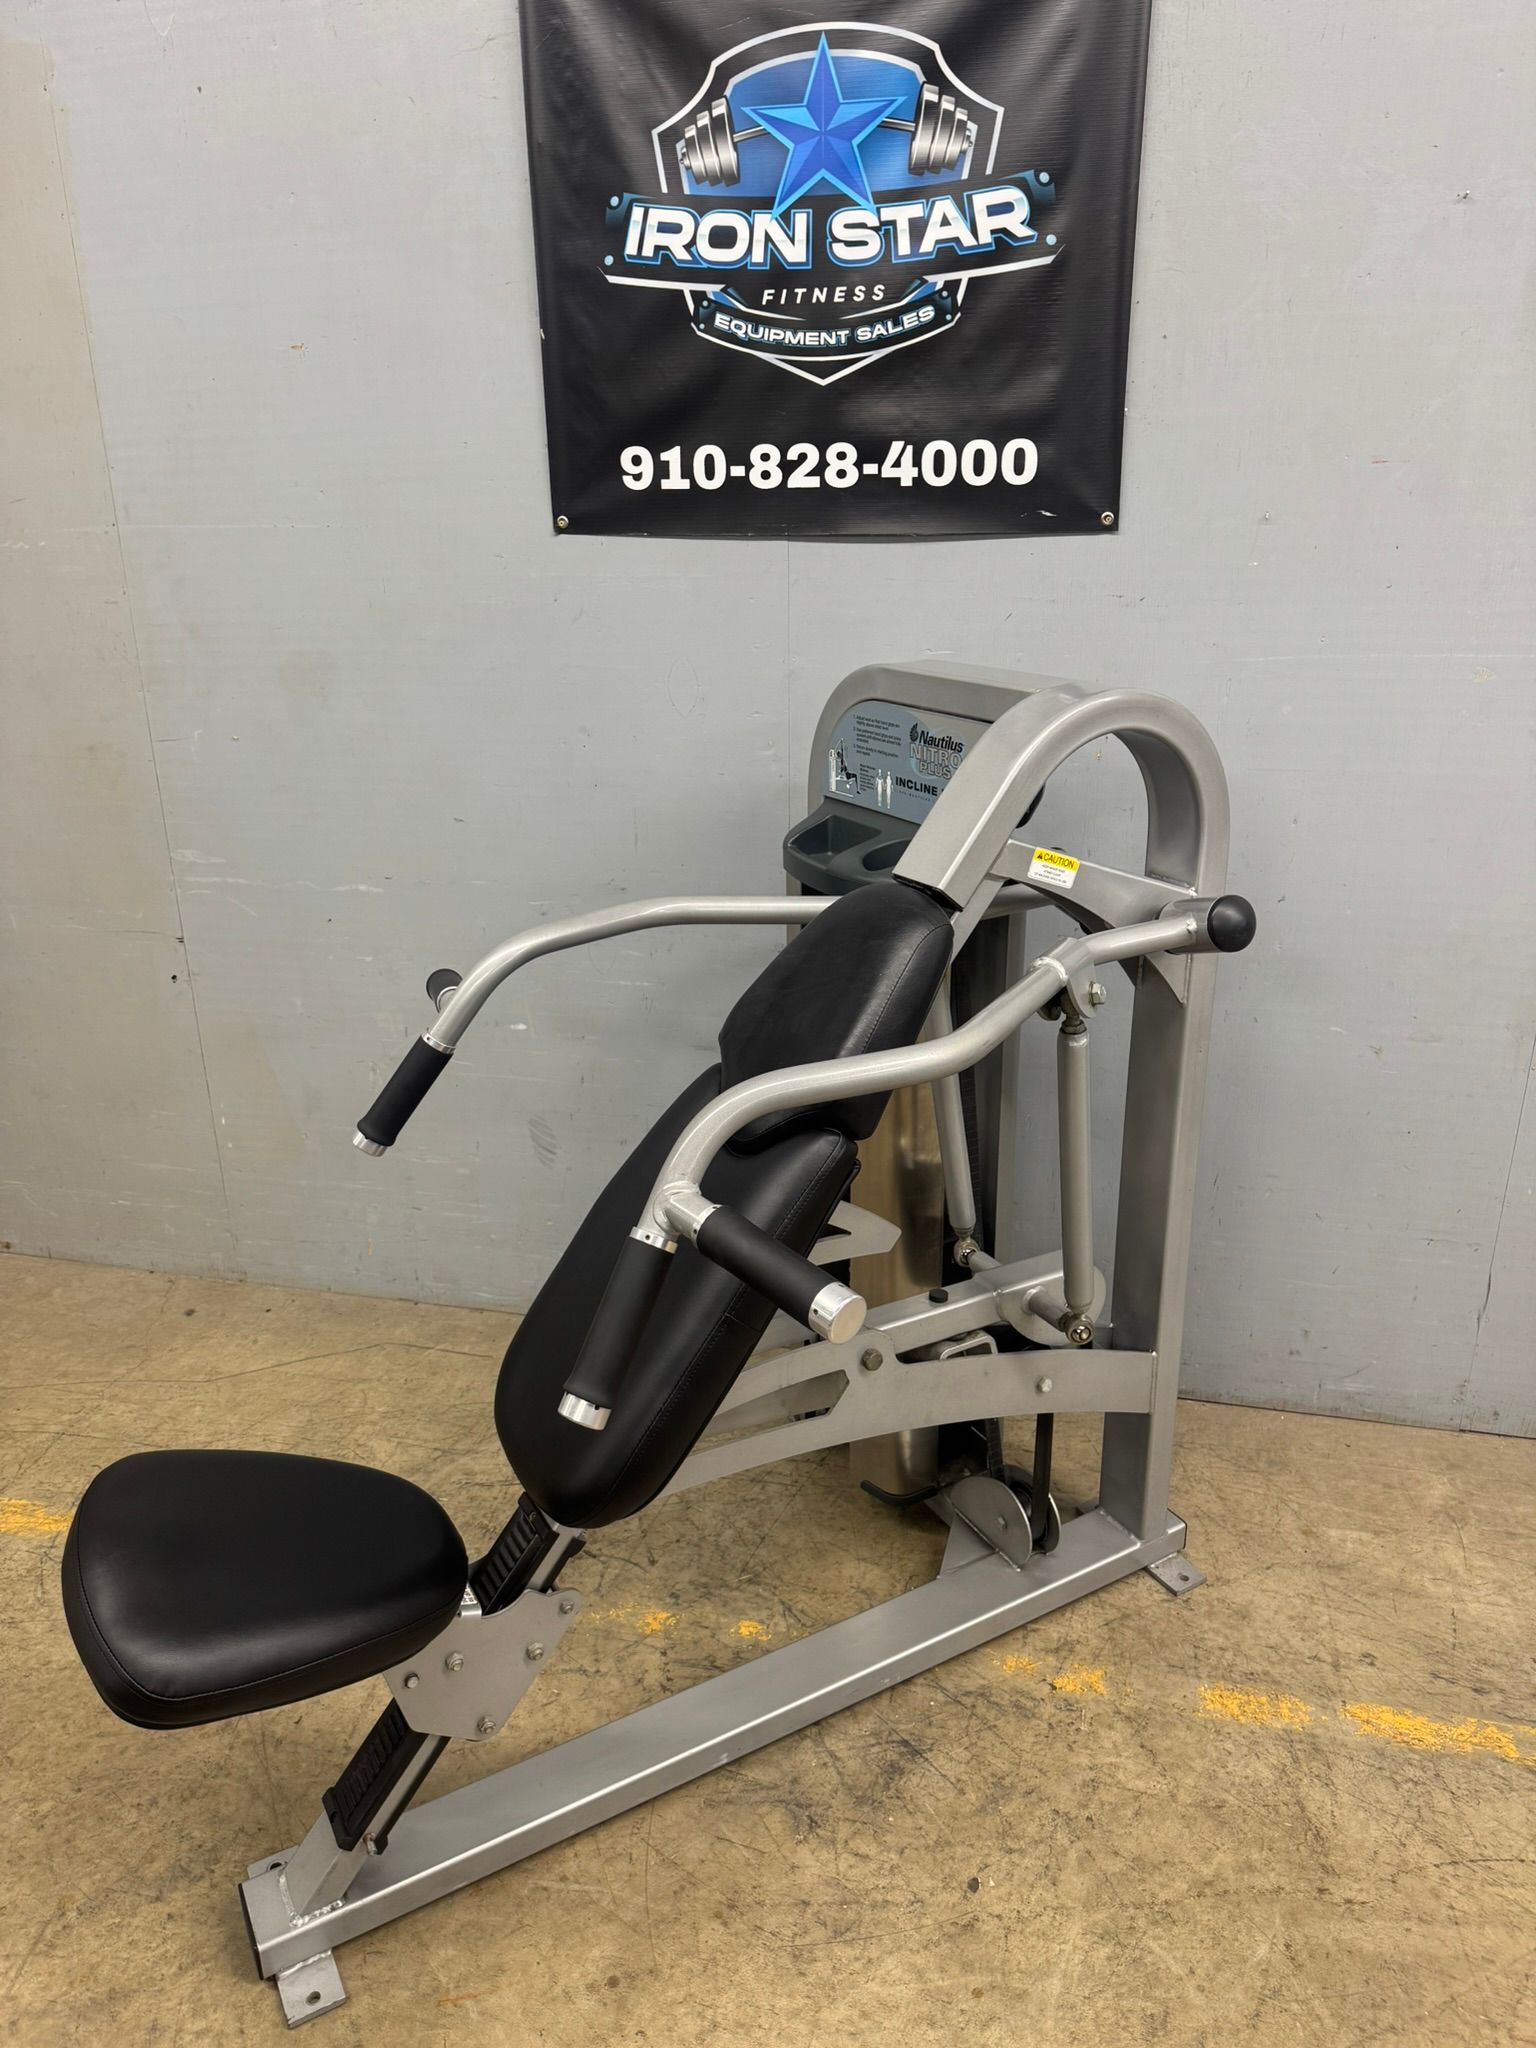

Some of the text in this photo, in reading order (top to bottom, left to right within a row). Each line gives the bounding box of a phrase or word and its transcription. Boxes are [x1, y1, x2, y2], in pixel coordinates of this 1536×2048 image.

[624, 185, 1038, 264] IRON STAR
[761, 284, 886, 306] FITNESS
[713, 304, 936, 347] EQUIPMENT SALES
[620, 438, 1039, 491] 910-828-4000
[918, 730, 965, 753] Nautilus
[909, 742, 963, 770] NITRO
[919, 759, 952, 781] PLUS
[895, 776, 938, 797] INCLINE
[1043, 853, 1075, 869] CAUTION
